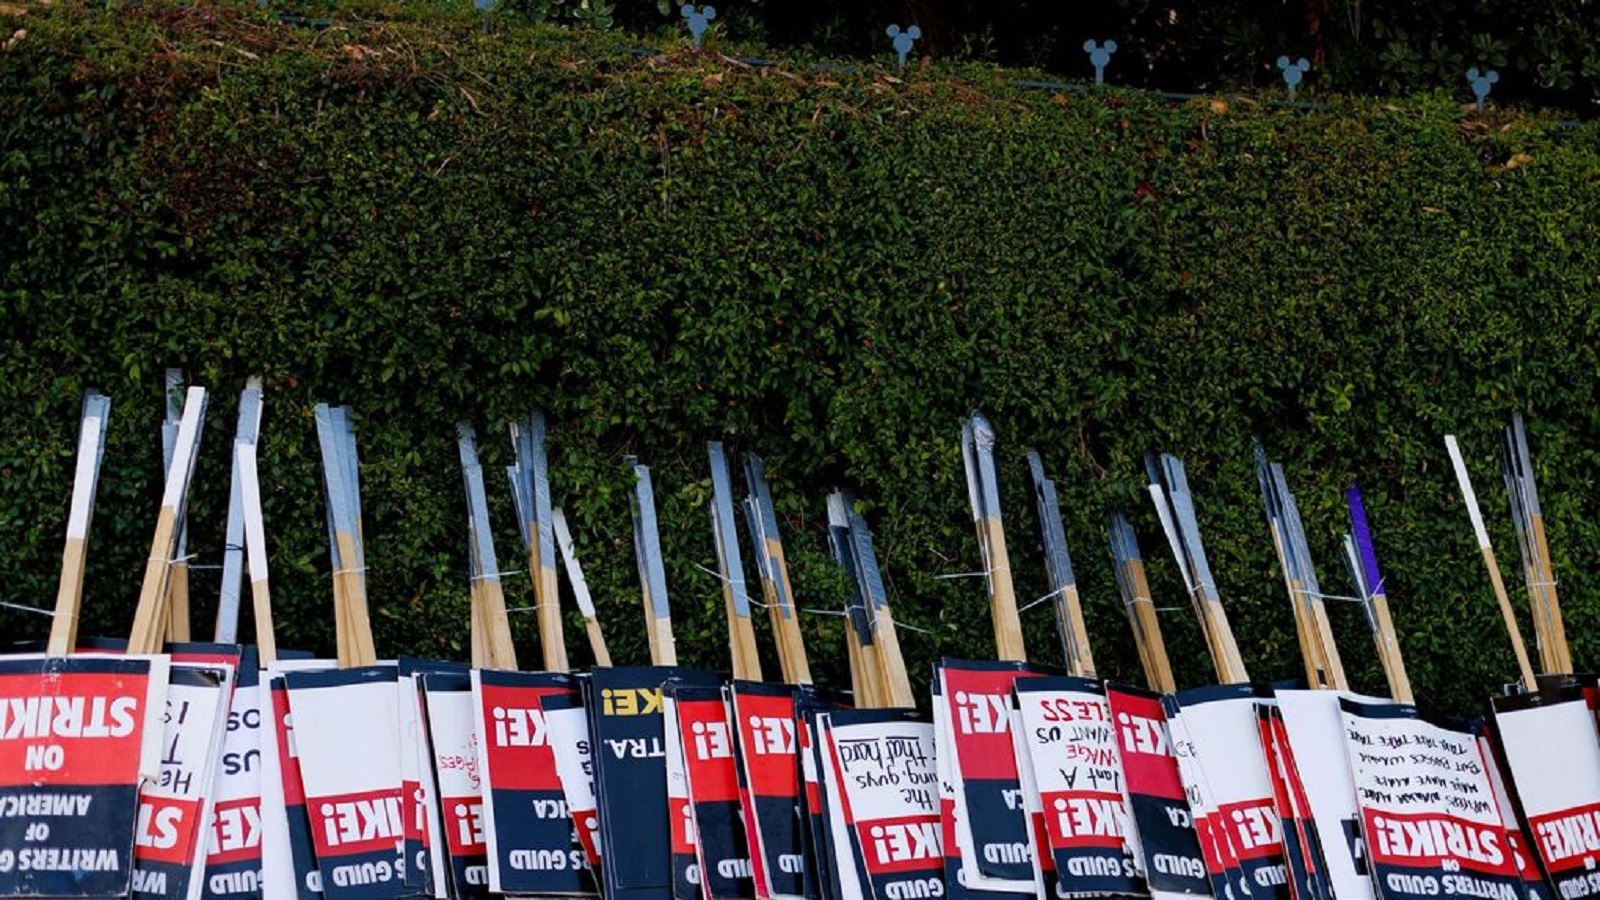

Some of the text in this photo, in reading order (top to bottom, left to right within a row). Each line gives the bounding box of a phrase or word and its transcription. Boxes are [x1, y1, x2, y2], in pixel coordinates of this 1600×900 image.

[0, 695, 138, 740] STRIK
[1036, 726, 1061, 744] US
[25, 744, 65, 772] ON
[838, 741, 884, 773] hard
[885, 739, 928, 768] that
[855, 764, 900, 790] guys
[1059, 766, 1078, 790] A
[899, 788, 934, 812] the
[24, 822, 51, 842] OF
[1373, 816, 1504, 866] STRIKE!
[17, 848, 119, 872] WRITERS
[508, 848, 567, 871] GUILD
[1067, 855, 1121, 877] GUILD
[1153, 853, 1206, 879] GUILD
[332, 859, 393, 887] GUILD
[1386, 872, 1518, 900] WRITERS GUILD
[885, 877, 945, 900] GUILD
